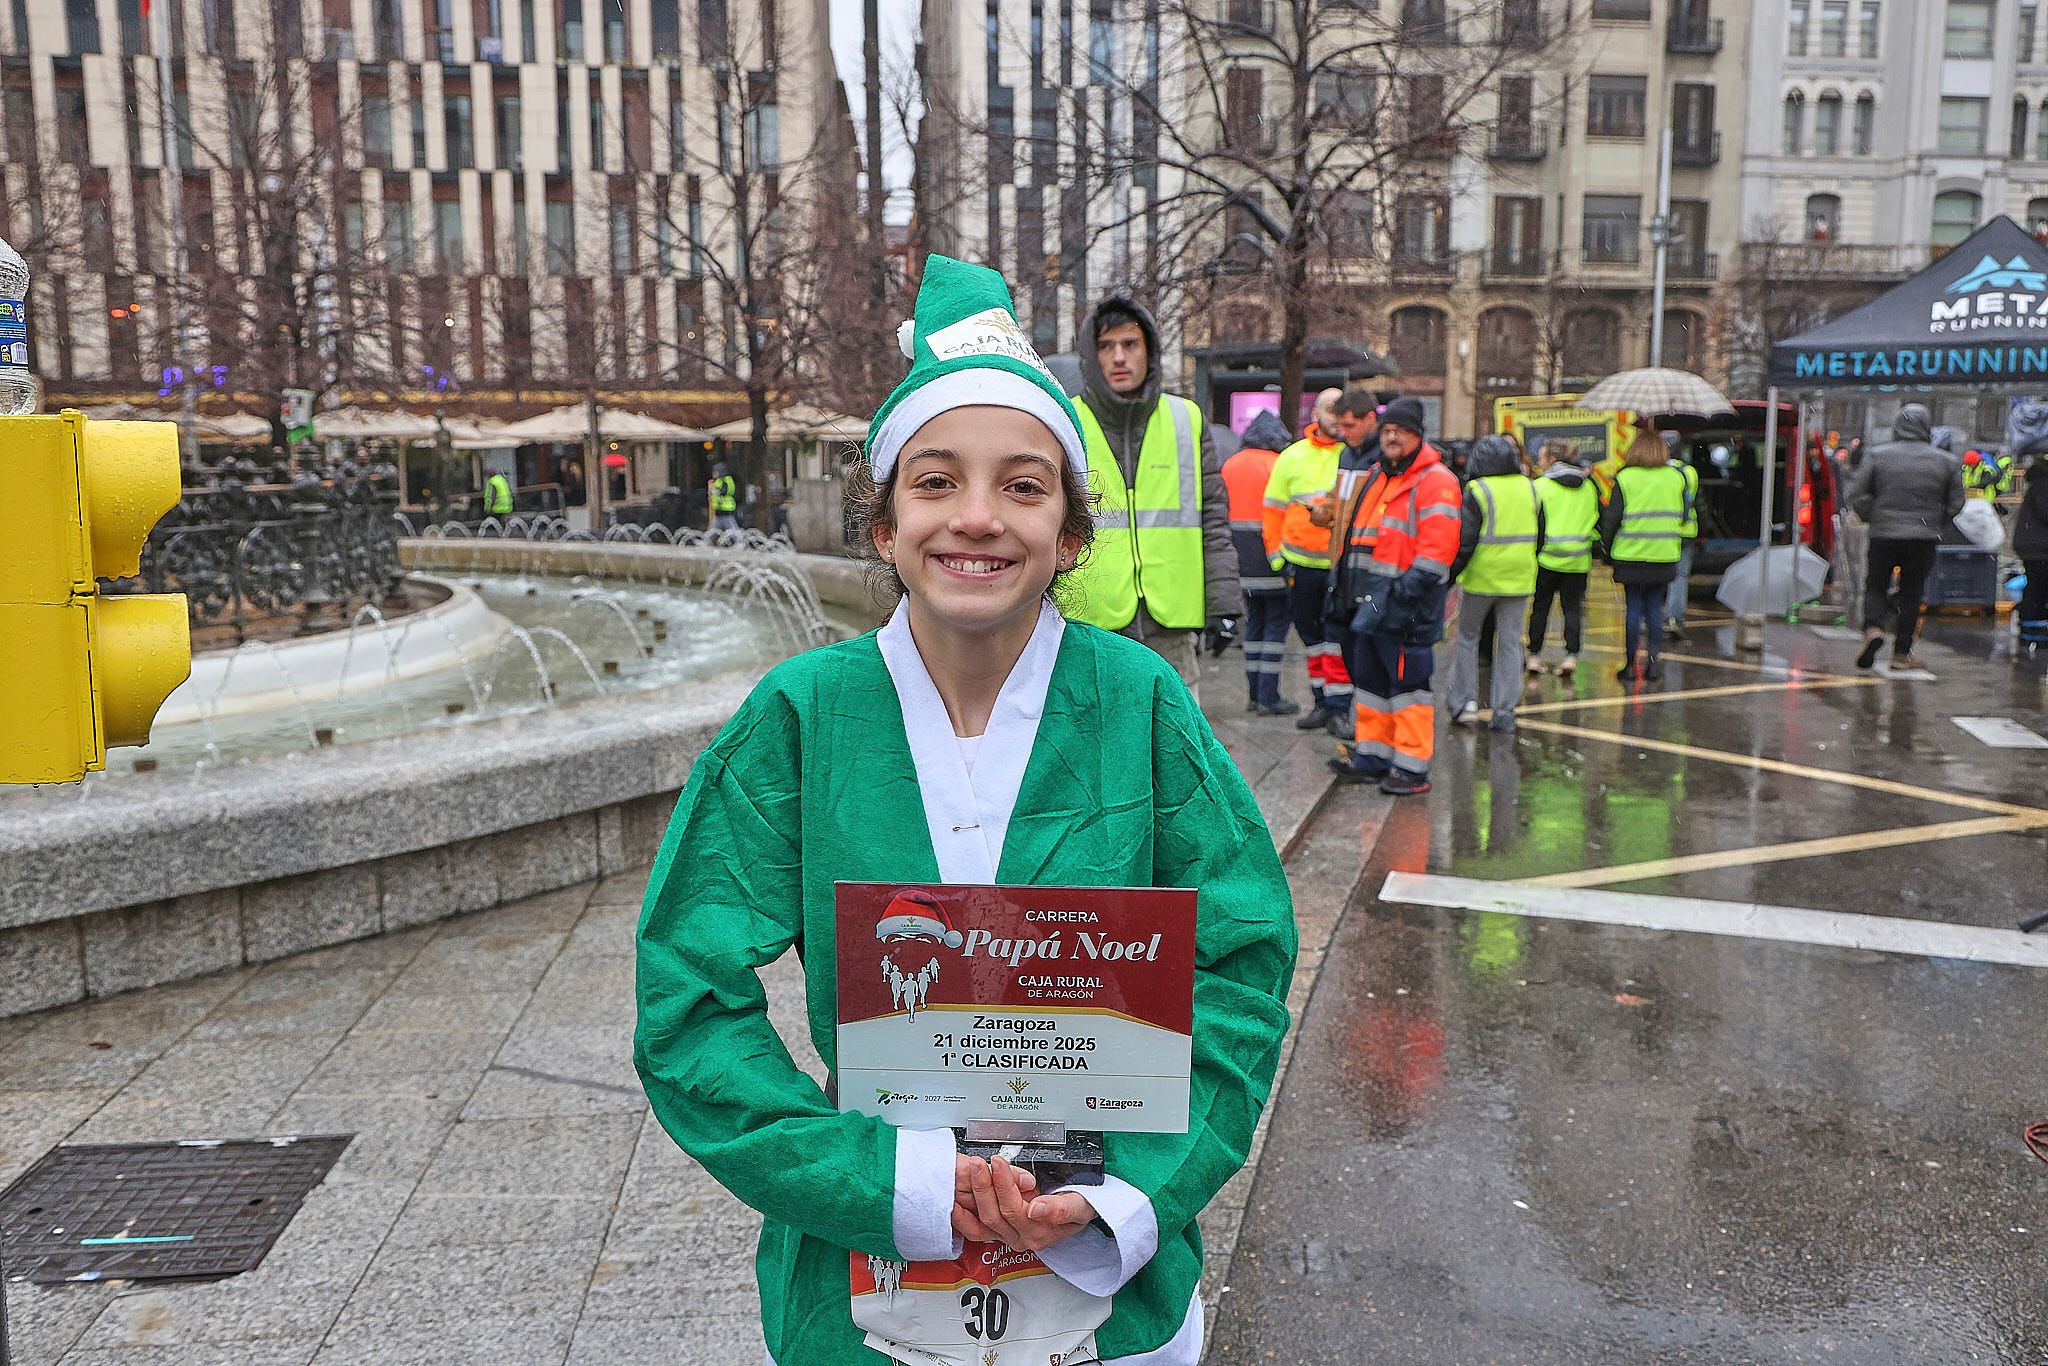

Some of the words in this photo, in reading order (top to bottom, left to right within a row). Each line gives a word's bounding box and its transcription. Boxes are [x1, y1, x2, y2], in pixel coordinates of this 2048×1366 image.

[943, 335, 1001, 354] CAJA
[963, 345, 988, 355] DE
[1025, 910, 1099, 923] CARRERA
[961, 929, 1062, 967] Papá
[1070, 931, 1163, 962] Noel
[1018, 975, 1053, 987] CAJA
[1056, 976, 1104, 988] RURAL
[1027, 989, 1043, 998] DE
[1045, 988, 1094, 999] ARAGÓN
[972, 1015, 1056, 1033] Zaragoza
[933, 1033, 953, 1048] 21
[960, 1034, 1049, 1050] diciembre
[1053, 1037, 1096, 1051] 2025
[941, 1052, 957, 1067] 1ª
[961, 1053, 1089, 1070] CLASIFICADA
[991, 1095, 1013, 1103] CAJA
[1015, 1096, 1045, 1104] RURAL
[1008, 1103, 1040, 1111] ARAGÓN
[1099, 1098, 1144, 1109] Zaragoza
[981, 1245, 1004, 1265] CAA
[998, 1251, 1039, 1269] ARAGÓN
[960, 1287, 1010, 1341] 30
